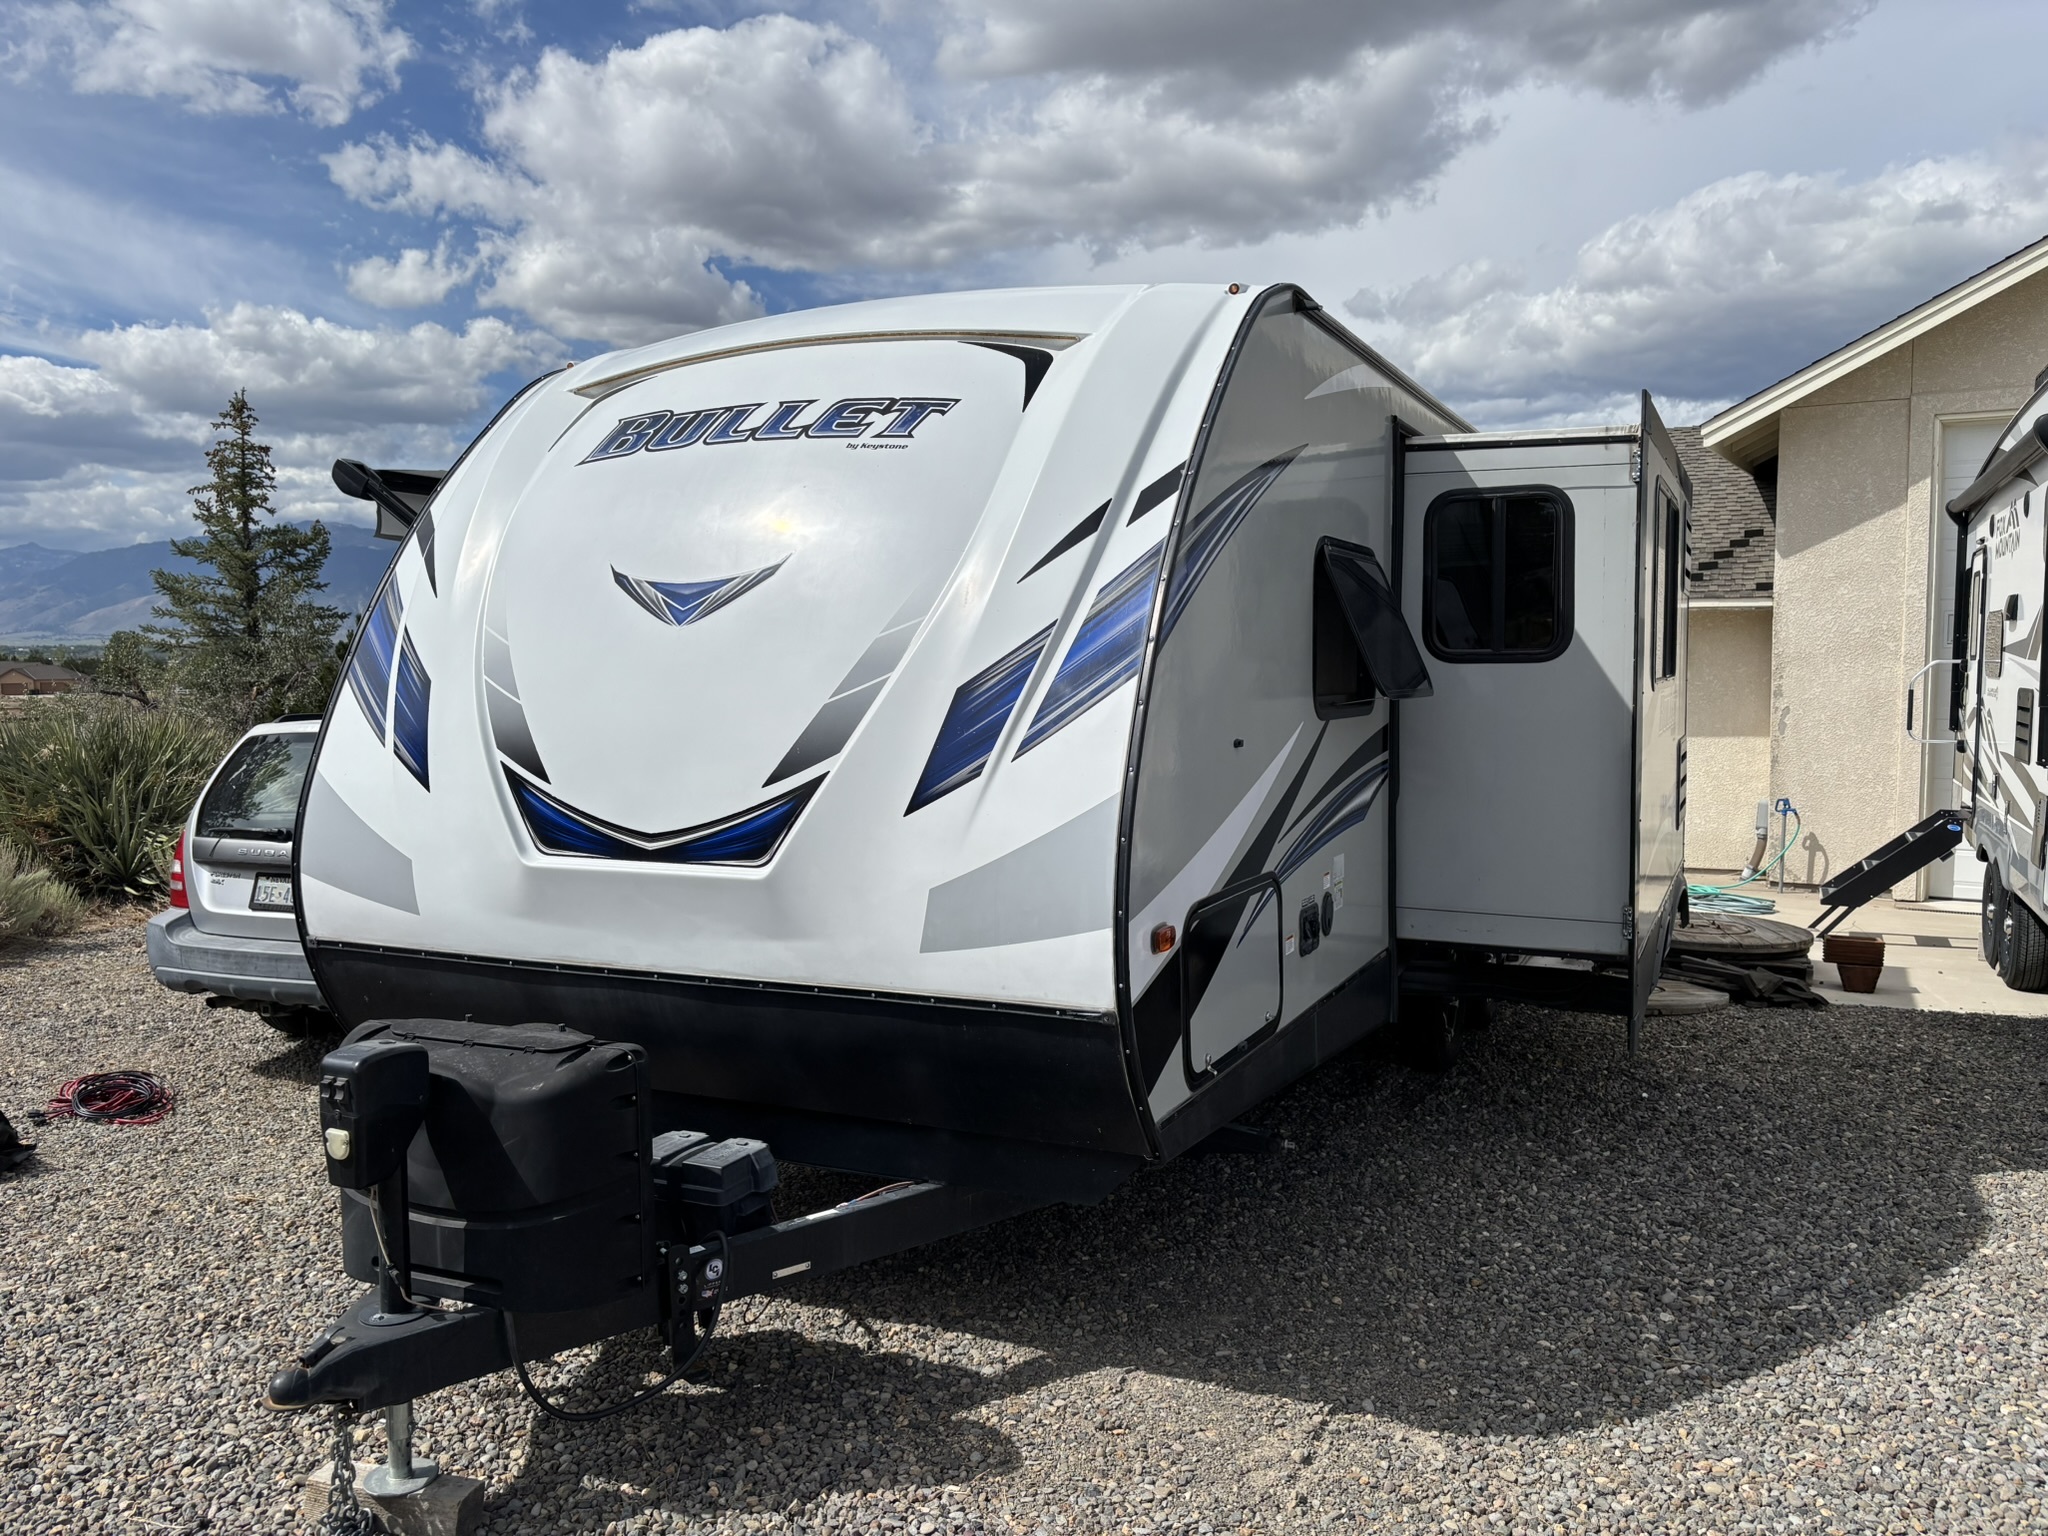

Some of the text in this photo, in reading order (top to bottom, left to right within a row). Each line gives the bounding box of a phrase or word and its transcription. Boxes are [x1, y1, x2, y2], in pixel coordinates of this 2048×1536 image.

[574, 397, 963, 467] BULLET
[846, 442, 909, 450] by Keystone
[1995, 528, 2020, 560] MOUNTAIN
[238, 848, 290, 858] SUBA
